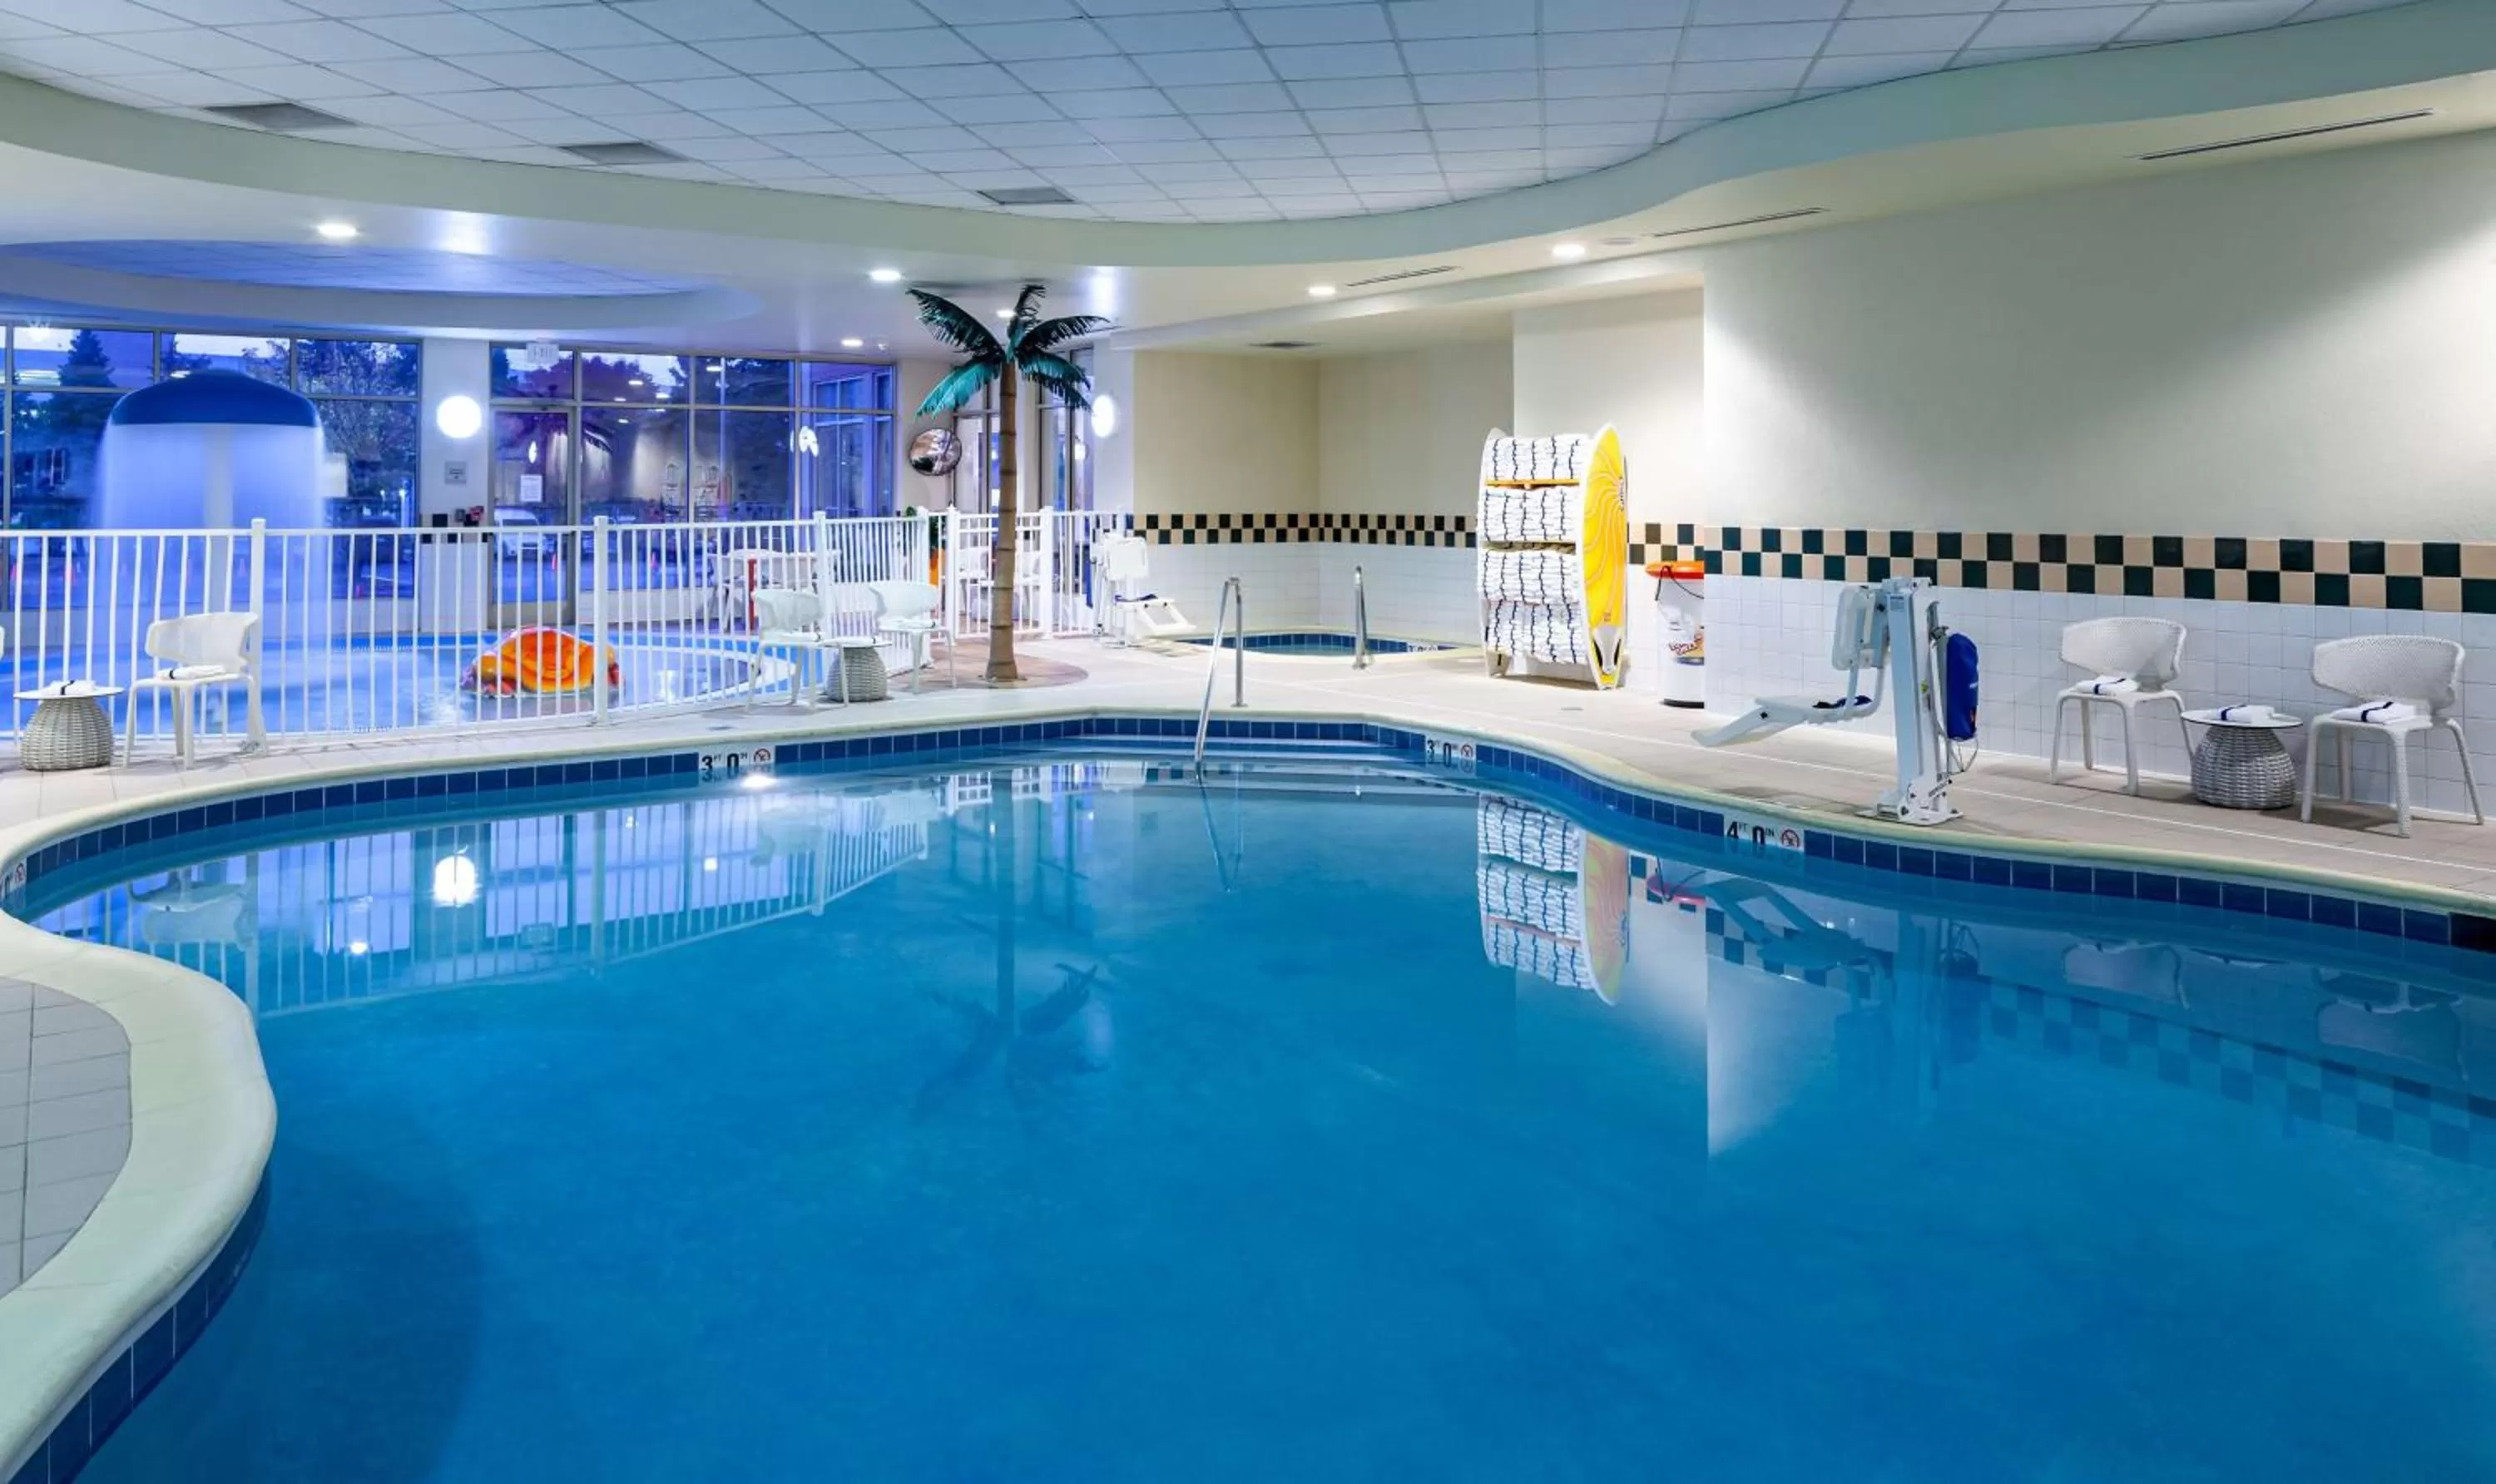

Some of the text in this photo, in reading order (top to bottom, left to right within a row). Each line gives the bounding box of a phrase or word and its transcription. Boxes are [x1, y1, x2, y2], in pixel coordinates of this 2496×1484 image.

[701, 754, 713, 770] 3
[1726, 820, 1739, 839] 4
[1752, 824, 1765, 844] 0
